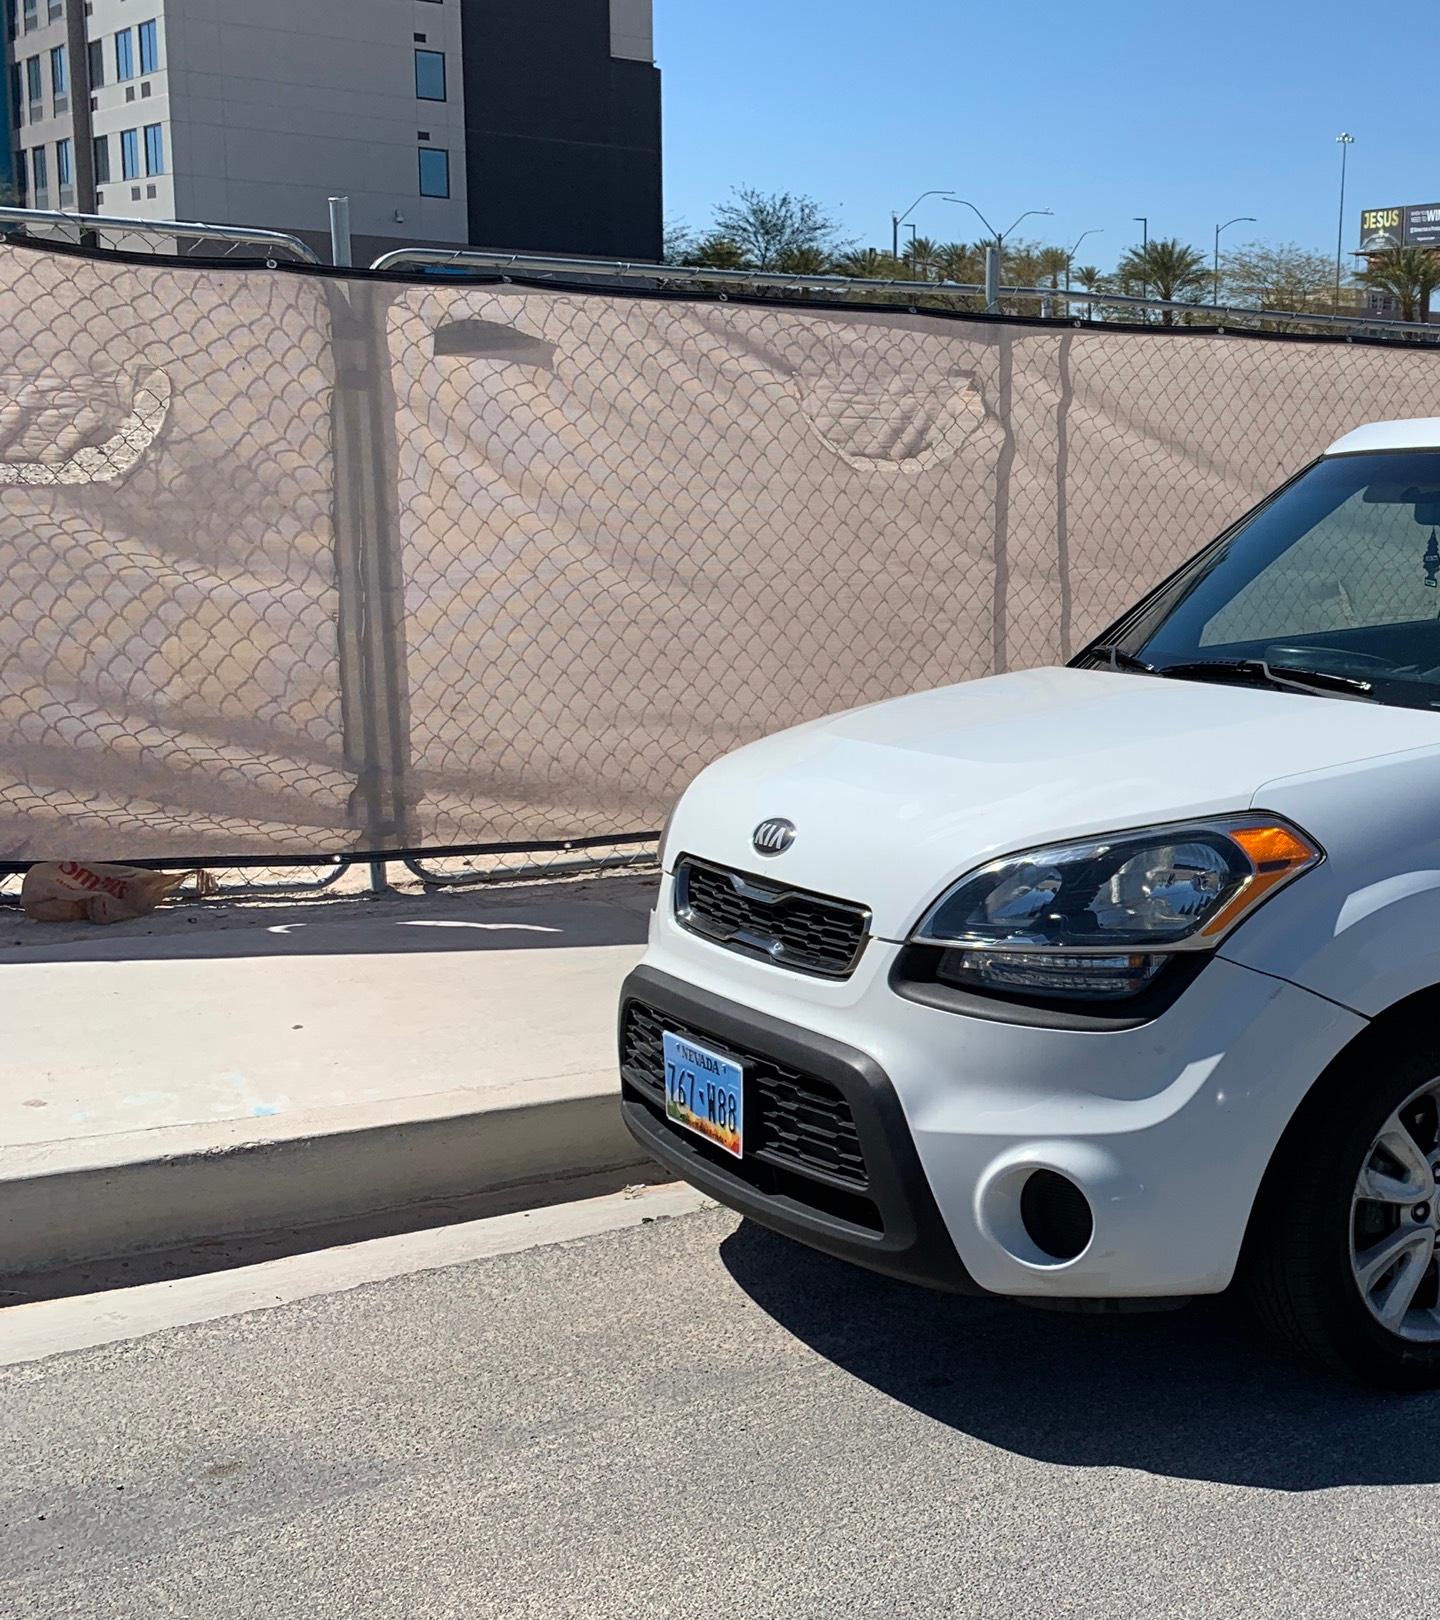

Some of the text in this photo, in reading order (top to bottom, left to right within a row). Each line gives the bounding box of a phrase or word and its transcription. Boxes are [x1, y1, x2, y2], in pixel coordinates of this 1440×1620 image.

[1363, 209, 1399, 229] JESUS
[754, 823, 786, 850] KIA
[682, 1045, 721, 1076] NEVADA
